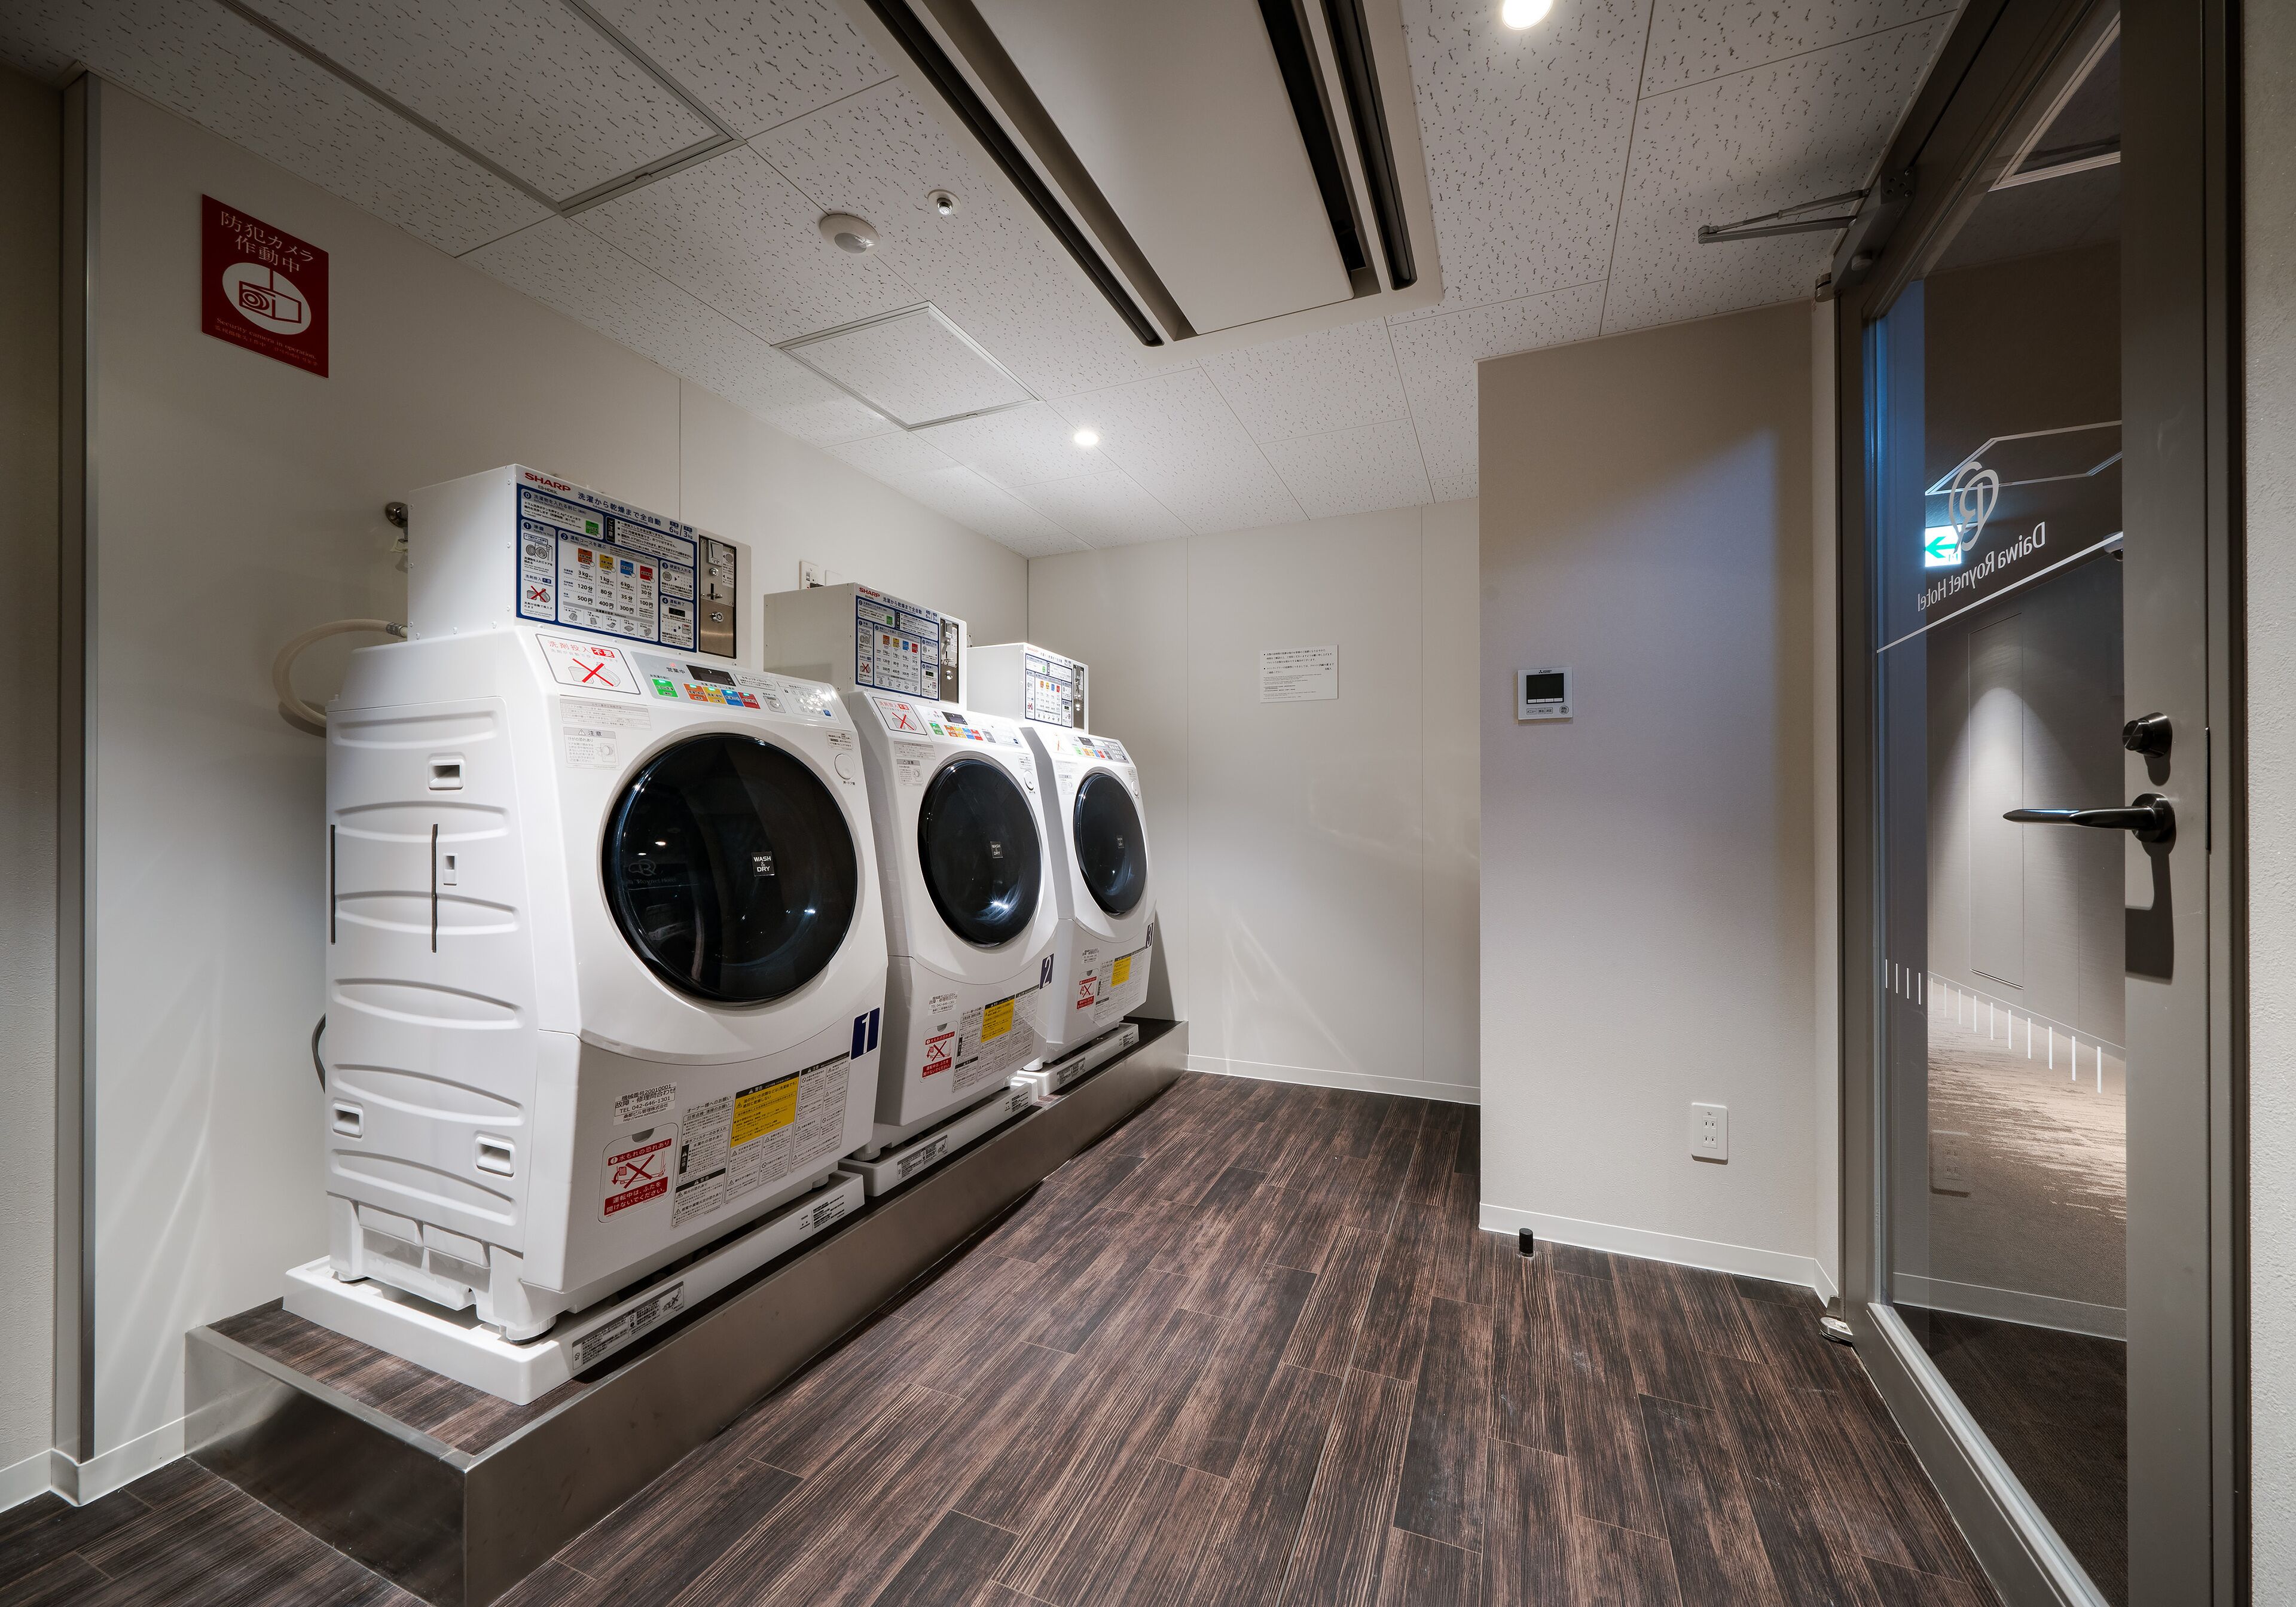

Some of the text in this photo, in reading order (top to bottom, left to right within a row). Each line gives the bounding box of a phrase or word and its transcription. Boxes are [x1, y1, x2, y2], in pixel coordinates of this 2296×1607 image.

[221, 210, 314, 262] 防犯カメラ
[235, 235, 300, 272] 作動中
[217, 317, 246, 334] Security
[249, 330, 274, 344] camera
[525, 472, 571, 491] SHARP
[578, 491, 661, 526] 洗濯から乾燥まで全自動
[859, 587, 880, 598] SHARP
[883, 597, 923, 615] 洗濯から乾燥まで全自動
[548, 640, 613, 657] 洗剤投入 不要
[1147, 924, 1152, 947] 3
[1043, 956, 1051, 987] 2
[862, 1012, 870, 1054] 1
[632, 1096, 670, 1110] 042-646-1301
[686, 1096, 731, 1114] オーナー様へのお願い
[619, 1140, 669, 1161] 水もれの恐れあり
[606, 1187, 665, 1214] 開けないでください。
[613, 1182, 661, 1203] 運転中は、ふたを
